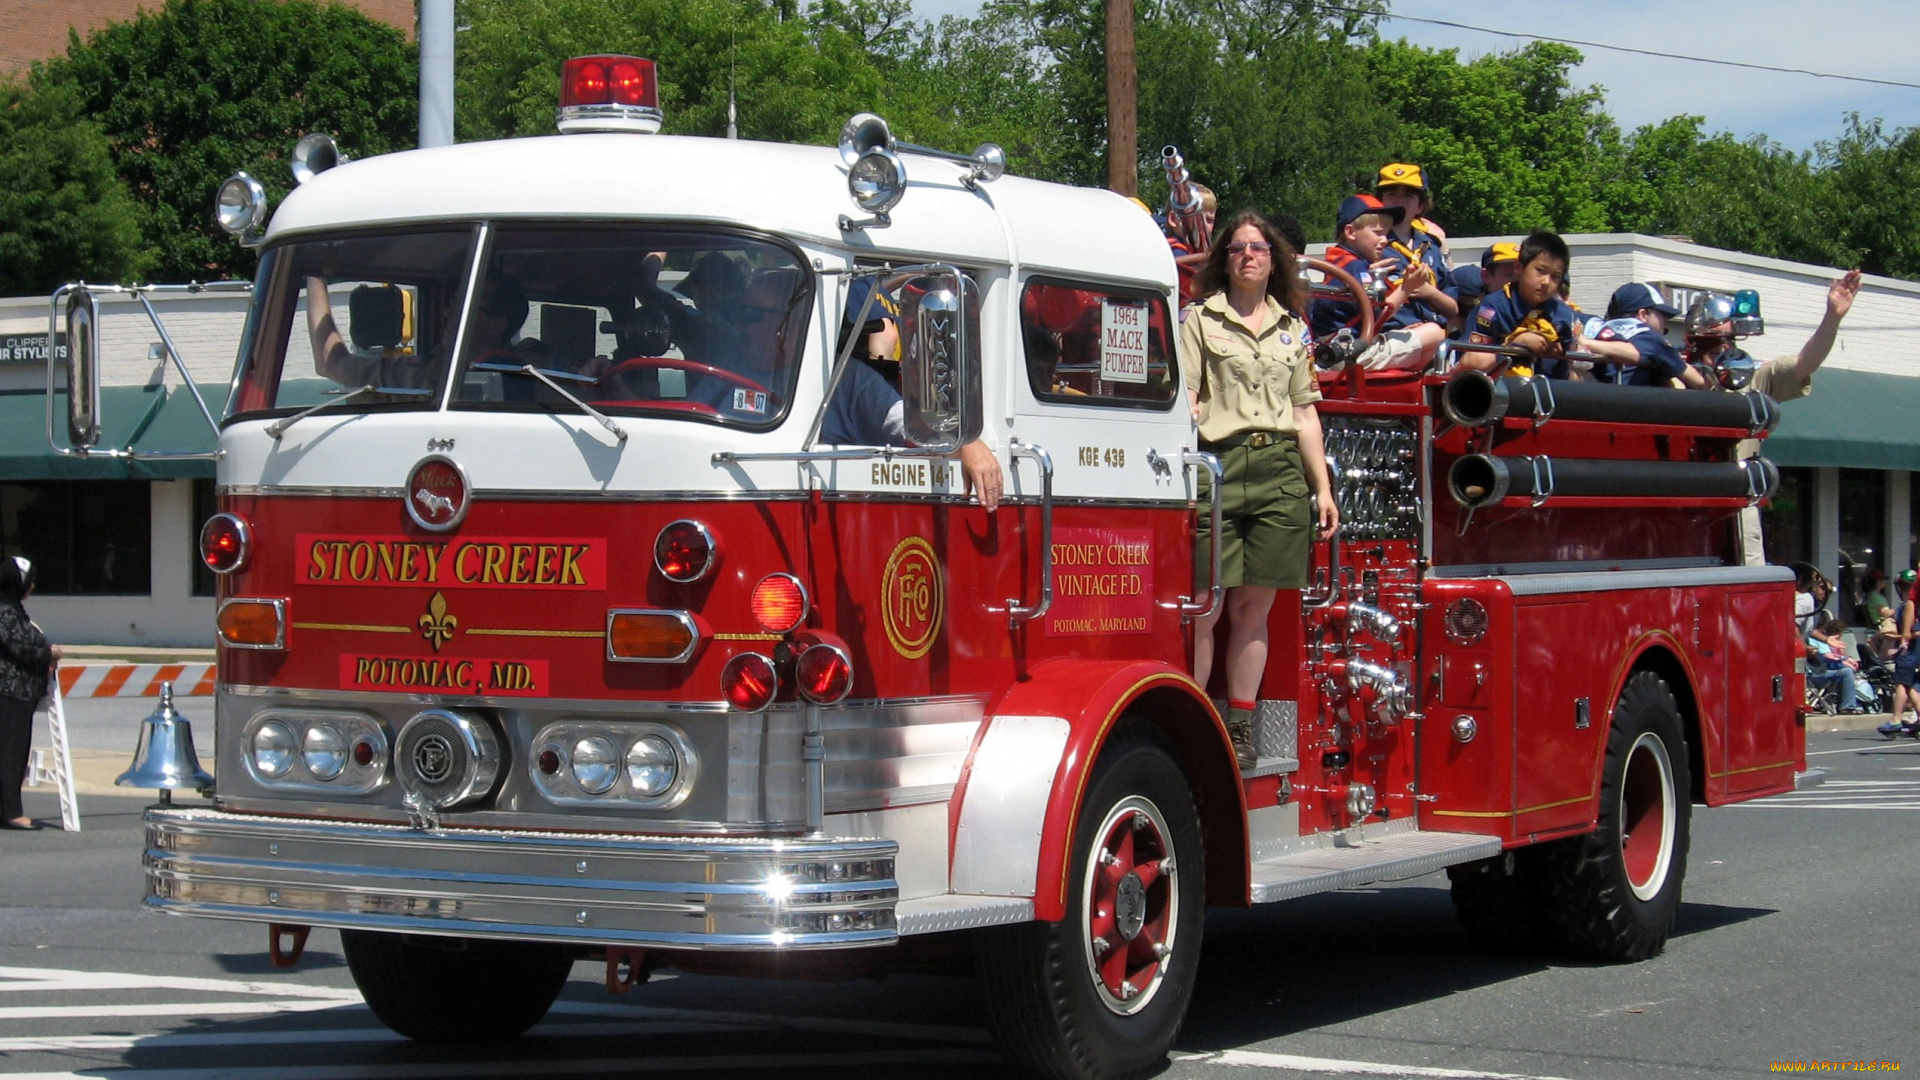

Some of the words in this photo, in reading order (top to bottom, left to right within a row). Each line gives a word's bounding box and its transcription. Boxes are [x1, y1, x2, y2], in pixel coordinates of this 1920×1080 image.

[1113, 307, 1139, 326] 1964
[1106, 328, 1144, 351] MACK
[1105, 352, 1144, 374] PUMPER
[756, 394, 765, 409] 07
[1104, 448, 1125, 468] 438
[871, 463, 925, 486] ENGINE
[309, 540, 447, 582] STONEY
[453, 543, 591, 586] CREEK
[1050, 543, 1104, 566] STONEY
[1106, 544, 1150, 566] CREEK
[1058, 574, 1118, 596] VINTAGE
[1120, 574, 1143, 595] F.D.
[1099, 617, 1147, 632] MARYLAND
[491, 661, 537, 691] MD.
